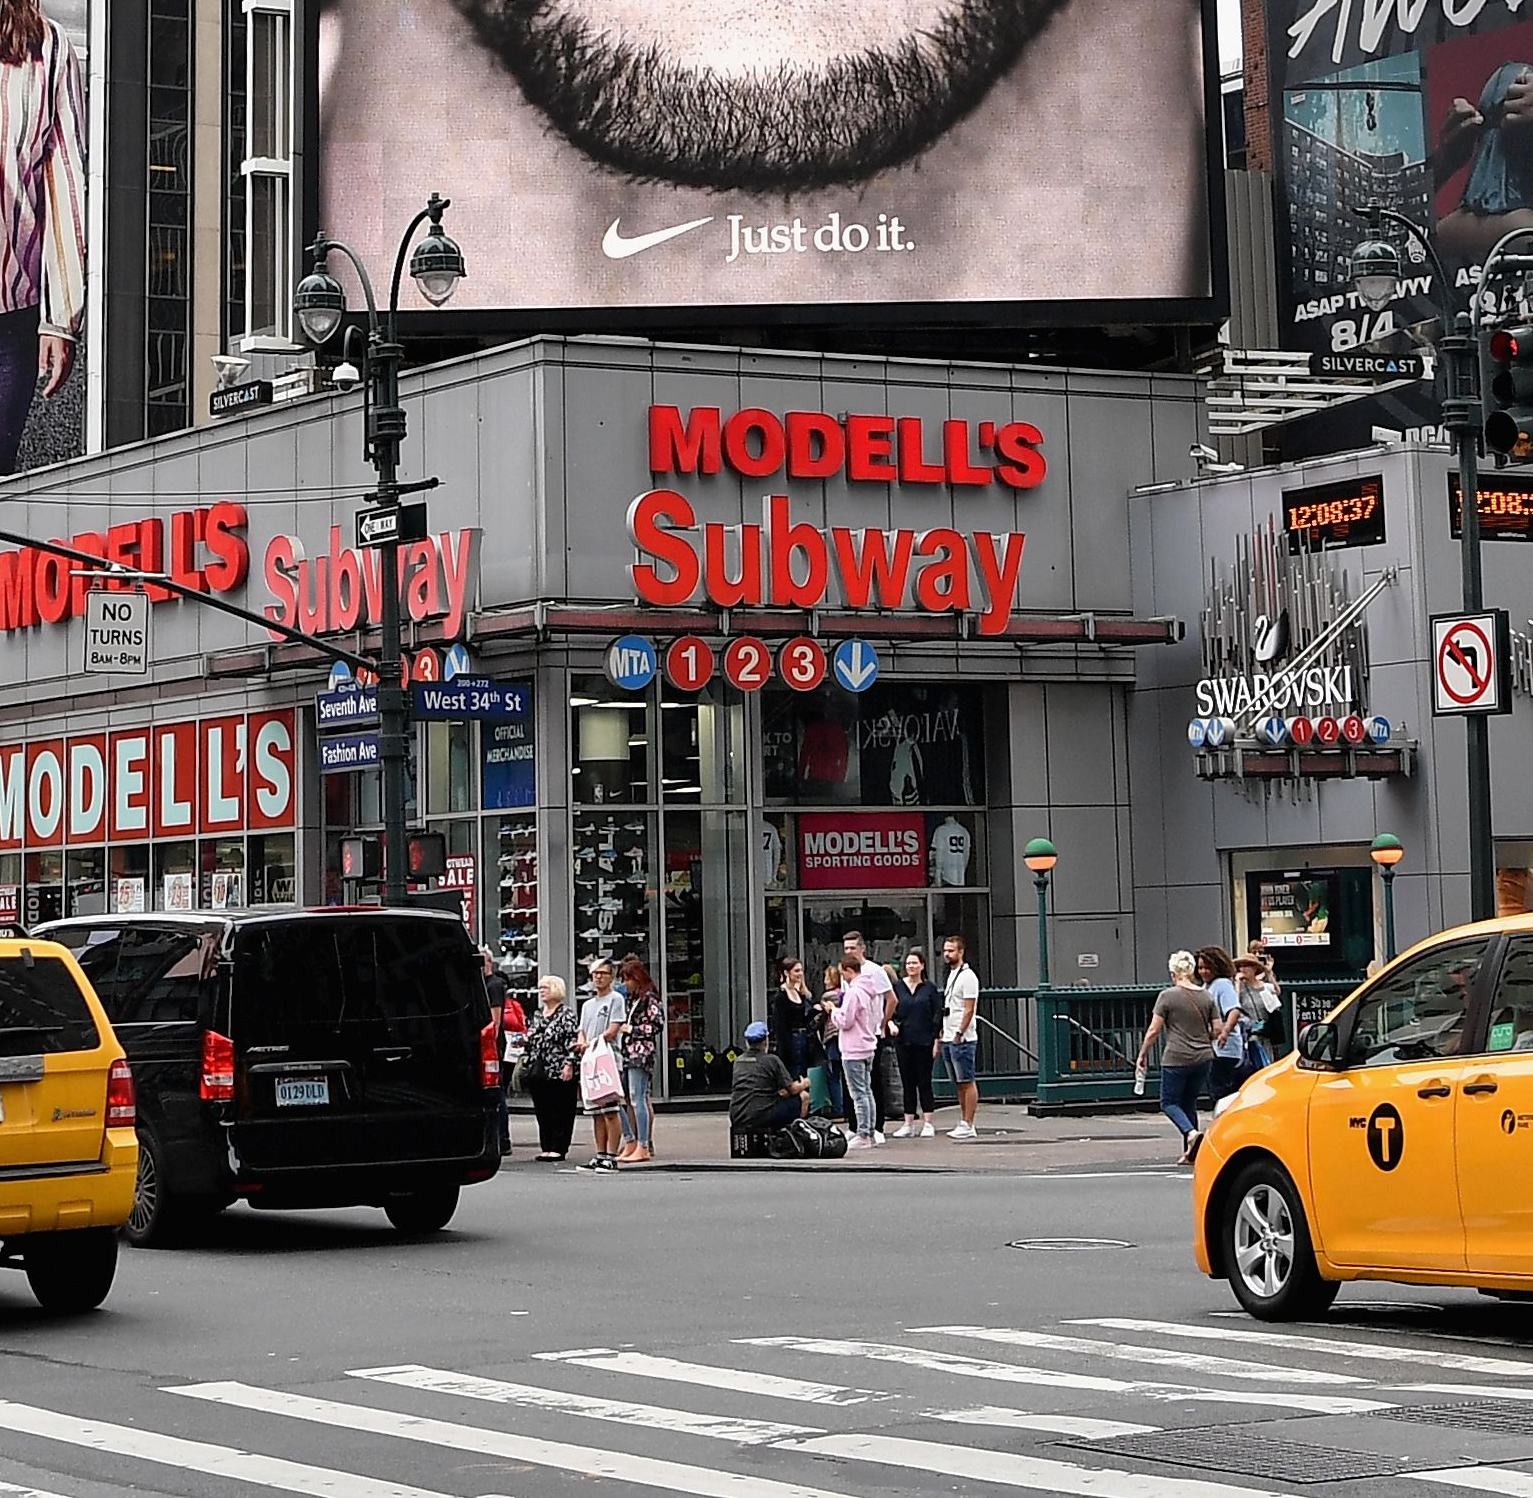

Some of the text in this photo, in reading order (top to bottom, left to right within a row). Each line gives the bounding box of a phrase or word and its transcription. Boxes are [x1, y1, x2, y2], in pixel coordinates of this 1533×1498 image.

[725, 213, 917, 263] Just do it.
[1330, 310, 1394, 353] 8/4
[1322, 357, 1416, 374] SILVERCAST
[213, 386, 260, 411] SILVERCAST
[647, 403, 1047, 488] MODELL'S
[1288, 495, 1375, 530] 12:08:37
[627, 489, 1026, 635] Subway
[102, 603, 132, 621] NO
[90, 628, 143, 646] TURNS
[609, 645, 816, 682] MTA 1 2 3
[424, 690, 522, 712] West 34th St
[1195, 665, 1354, 716] SWAROVSKI
[320, 694, 377, 718] Seventh Ave
[495, 724, 525, 741] OFFICIAL
[322, 741, 377, 765] Fashion Ave
[486, 744, 534, 764] MERCHANDISE
[804, 829, 920, 855] MODELL'S
[949, 835, 965, 853] 99
[805, 854, 920, 868] SPORTING GOODS
[438, 868, 474, 887] SALE
[1349, 1117, 1367, 1128] NYC
